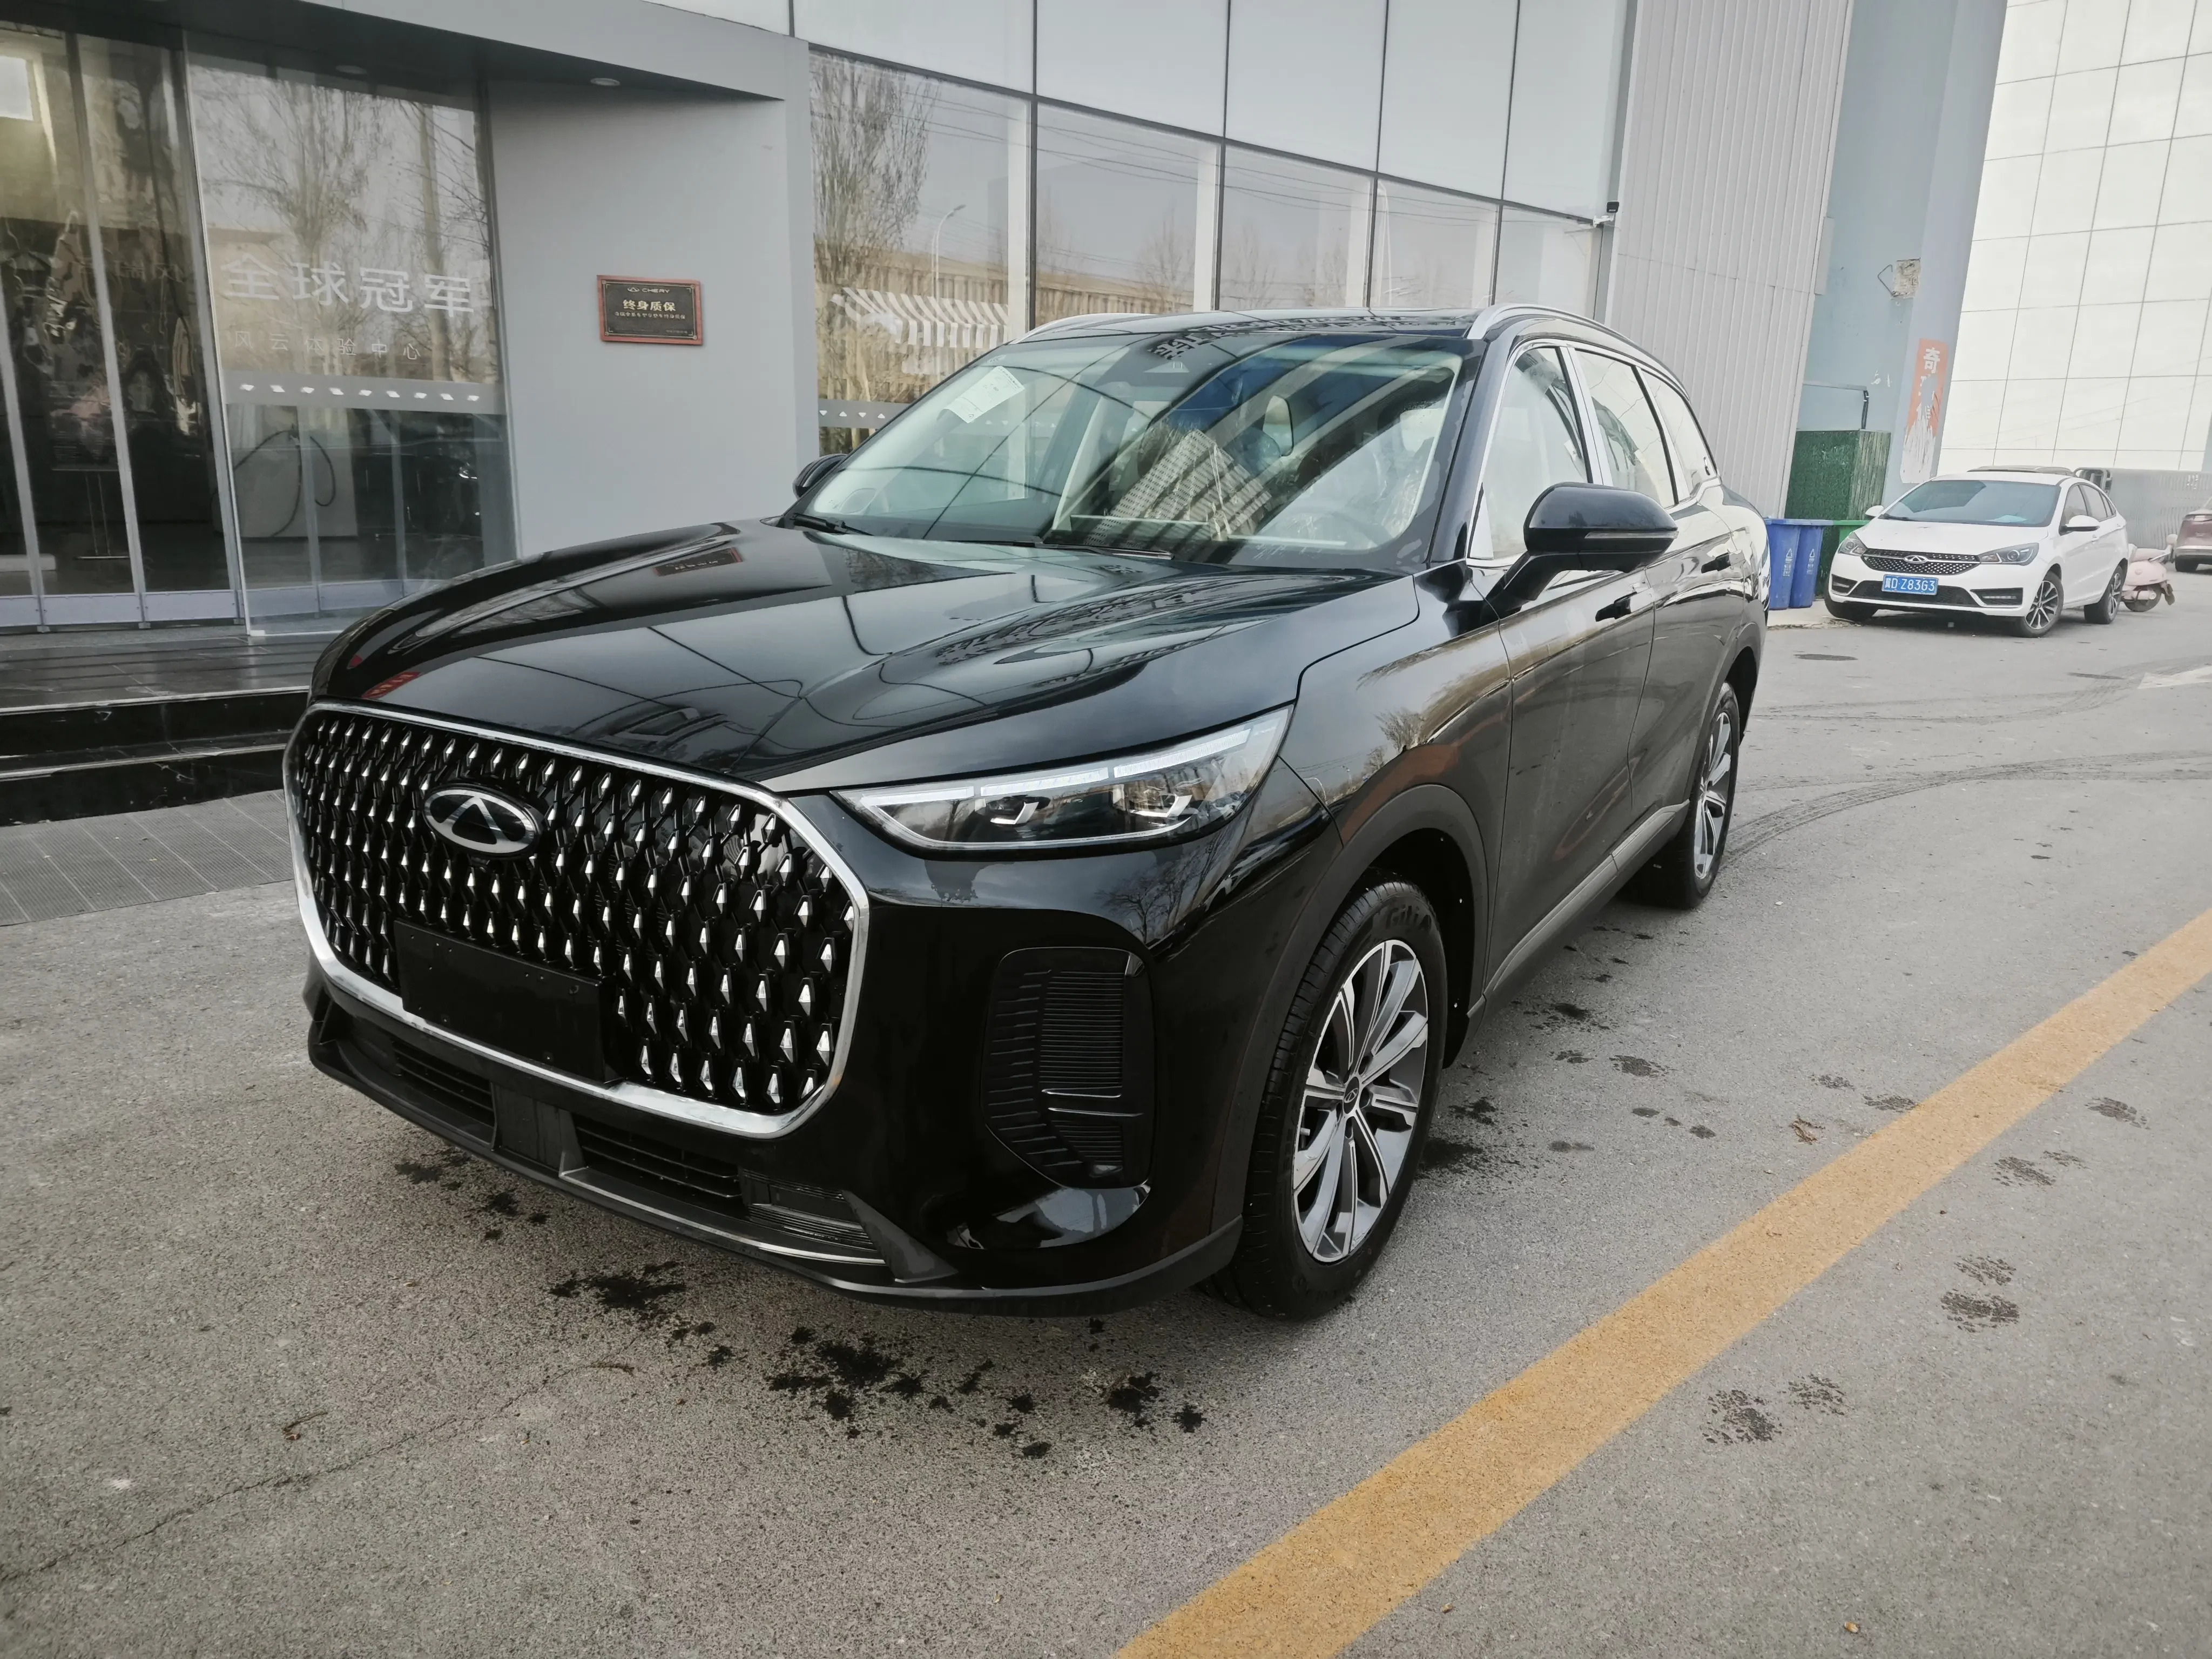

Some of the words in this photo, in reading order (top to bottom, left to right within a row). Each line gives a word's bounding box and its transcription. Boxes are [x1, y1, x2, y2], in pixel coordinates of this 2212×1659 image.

[220, 253, 474, 318] 全球冠军
[623, 299, 676, 312] 终身质保
[234, 330, 421, 361] 风云体验中心
